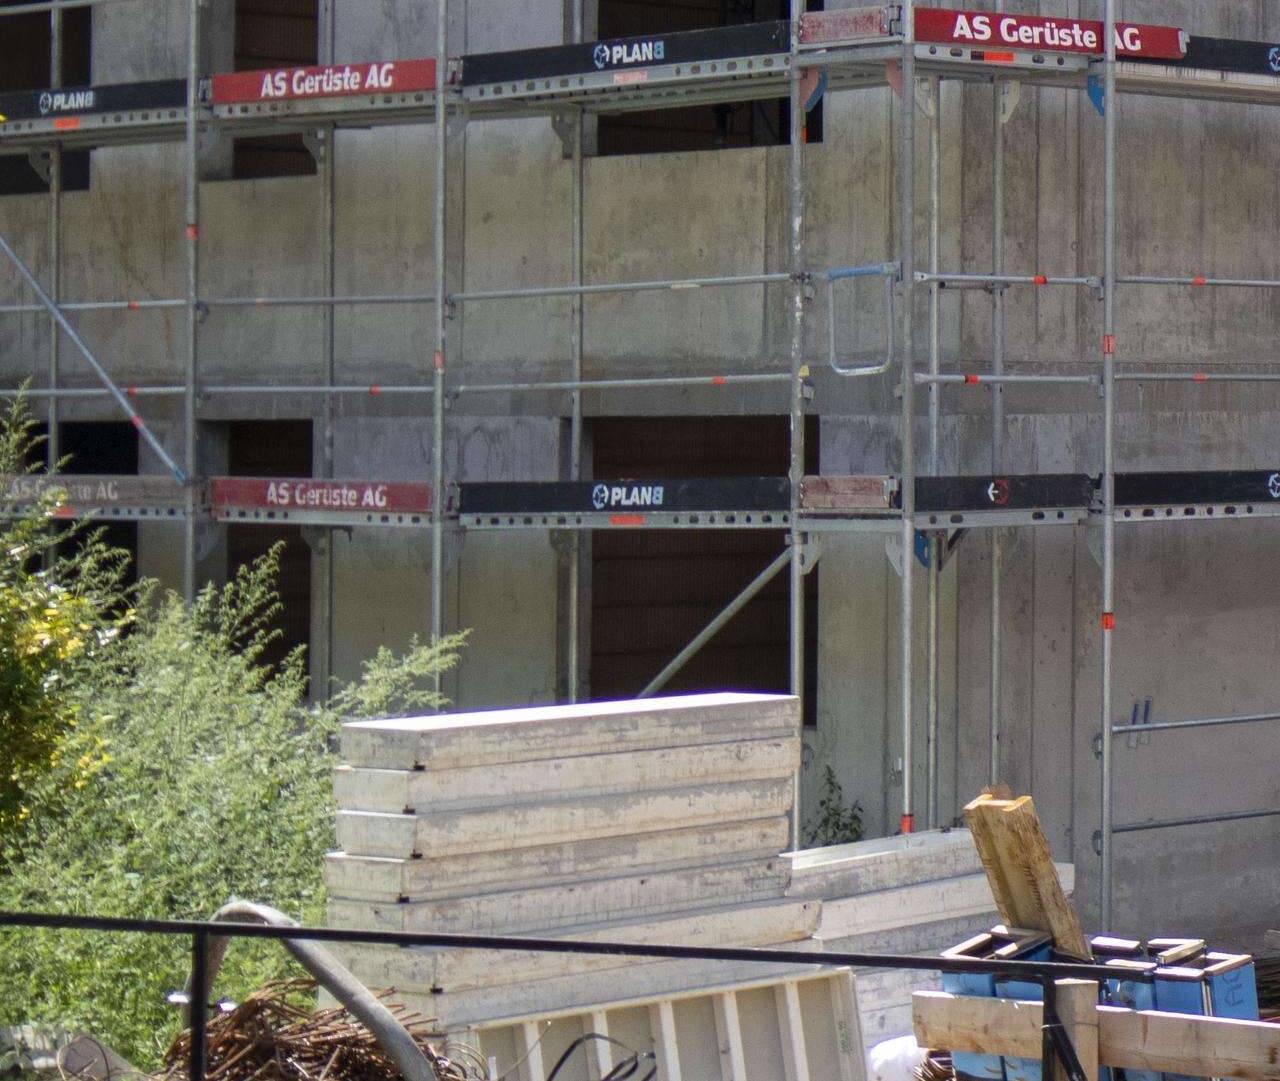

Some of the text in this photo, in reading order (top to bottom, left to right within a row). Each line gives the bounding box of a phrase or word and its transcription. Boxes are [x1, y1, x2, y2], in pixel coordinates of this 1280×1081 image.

[953, 14, 992, 40] AS
[1000, 18, 1097, 48] Gerüste
[612, 41, 664, 64] PLANB
[261, 63, 394, 98] AS Gerüste AG
[267, 481, 290, 505] AS
[362, 484, 388, 507] AG
[611, 486, 663, 506] PLANB
